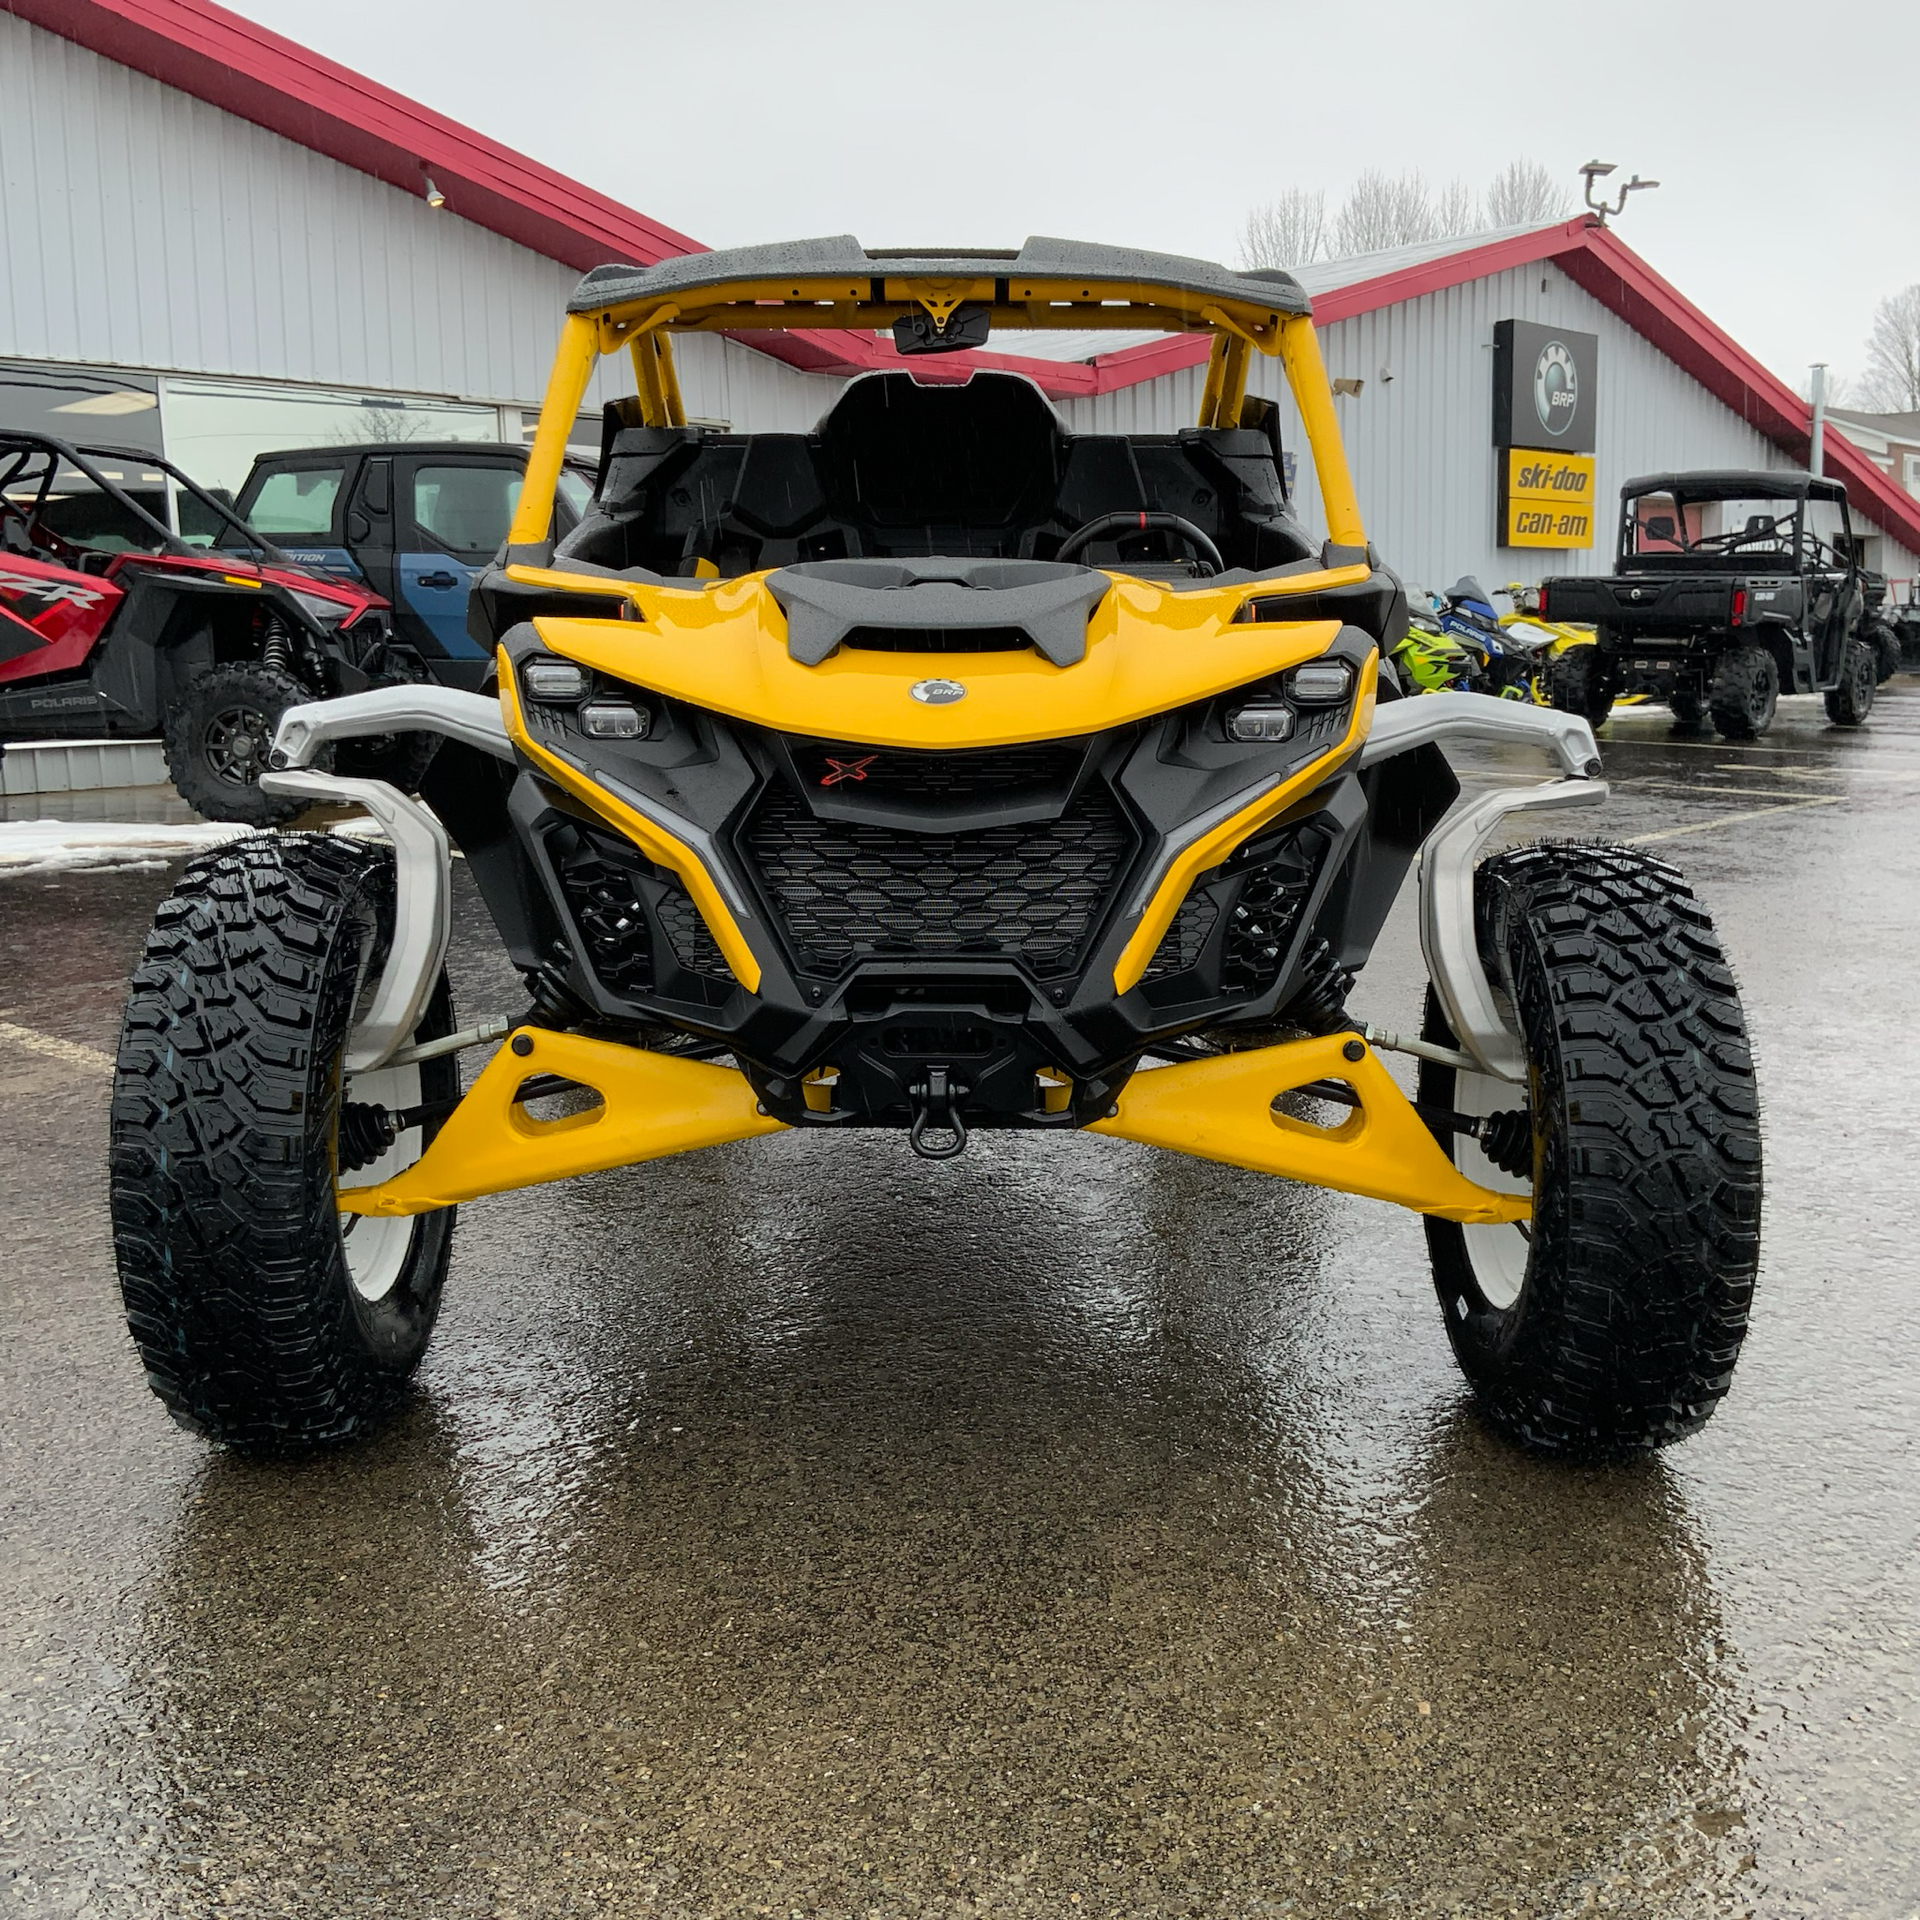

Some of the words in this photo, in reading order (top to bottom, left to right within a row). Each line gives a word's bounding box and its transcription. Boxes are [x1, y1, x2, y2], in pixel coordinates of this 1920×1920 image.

[1551, 391, 1574, 408] BRP
[1517, 463, 1587, 492] ski-doo
[1516, 511, 1588, 537] can-am
[285, 553, 325, 562] DITION
[1449, 620, 1486, 642] POLARIS
[932, 688, 964, 696] BRP
[31, 696, 98, 709] POLARIS
